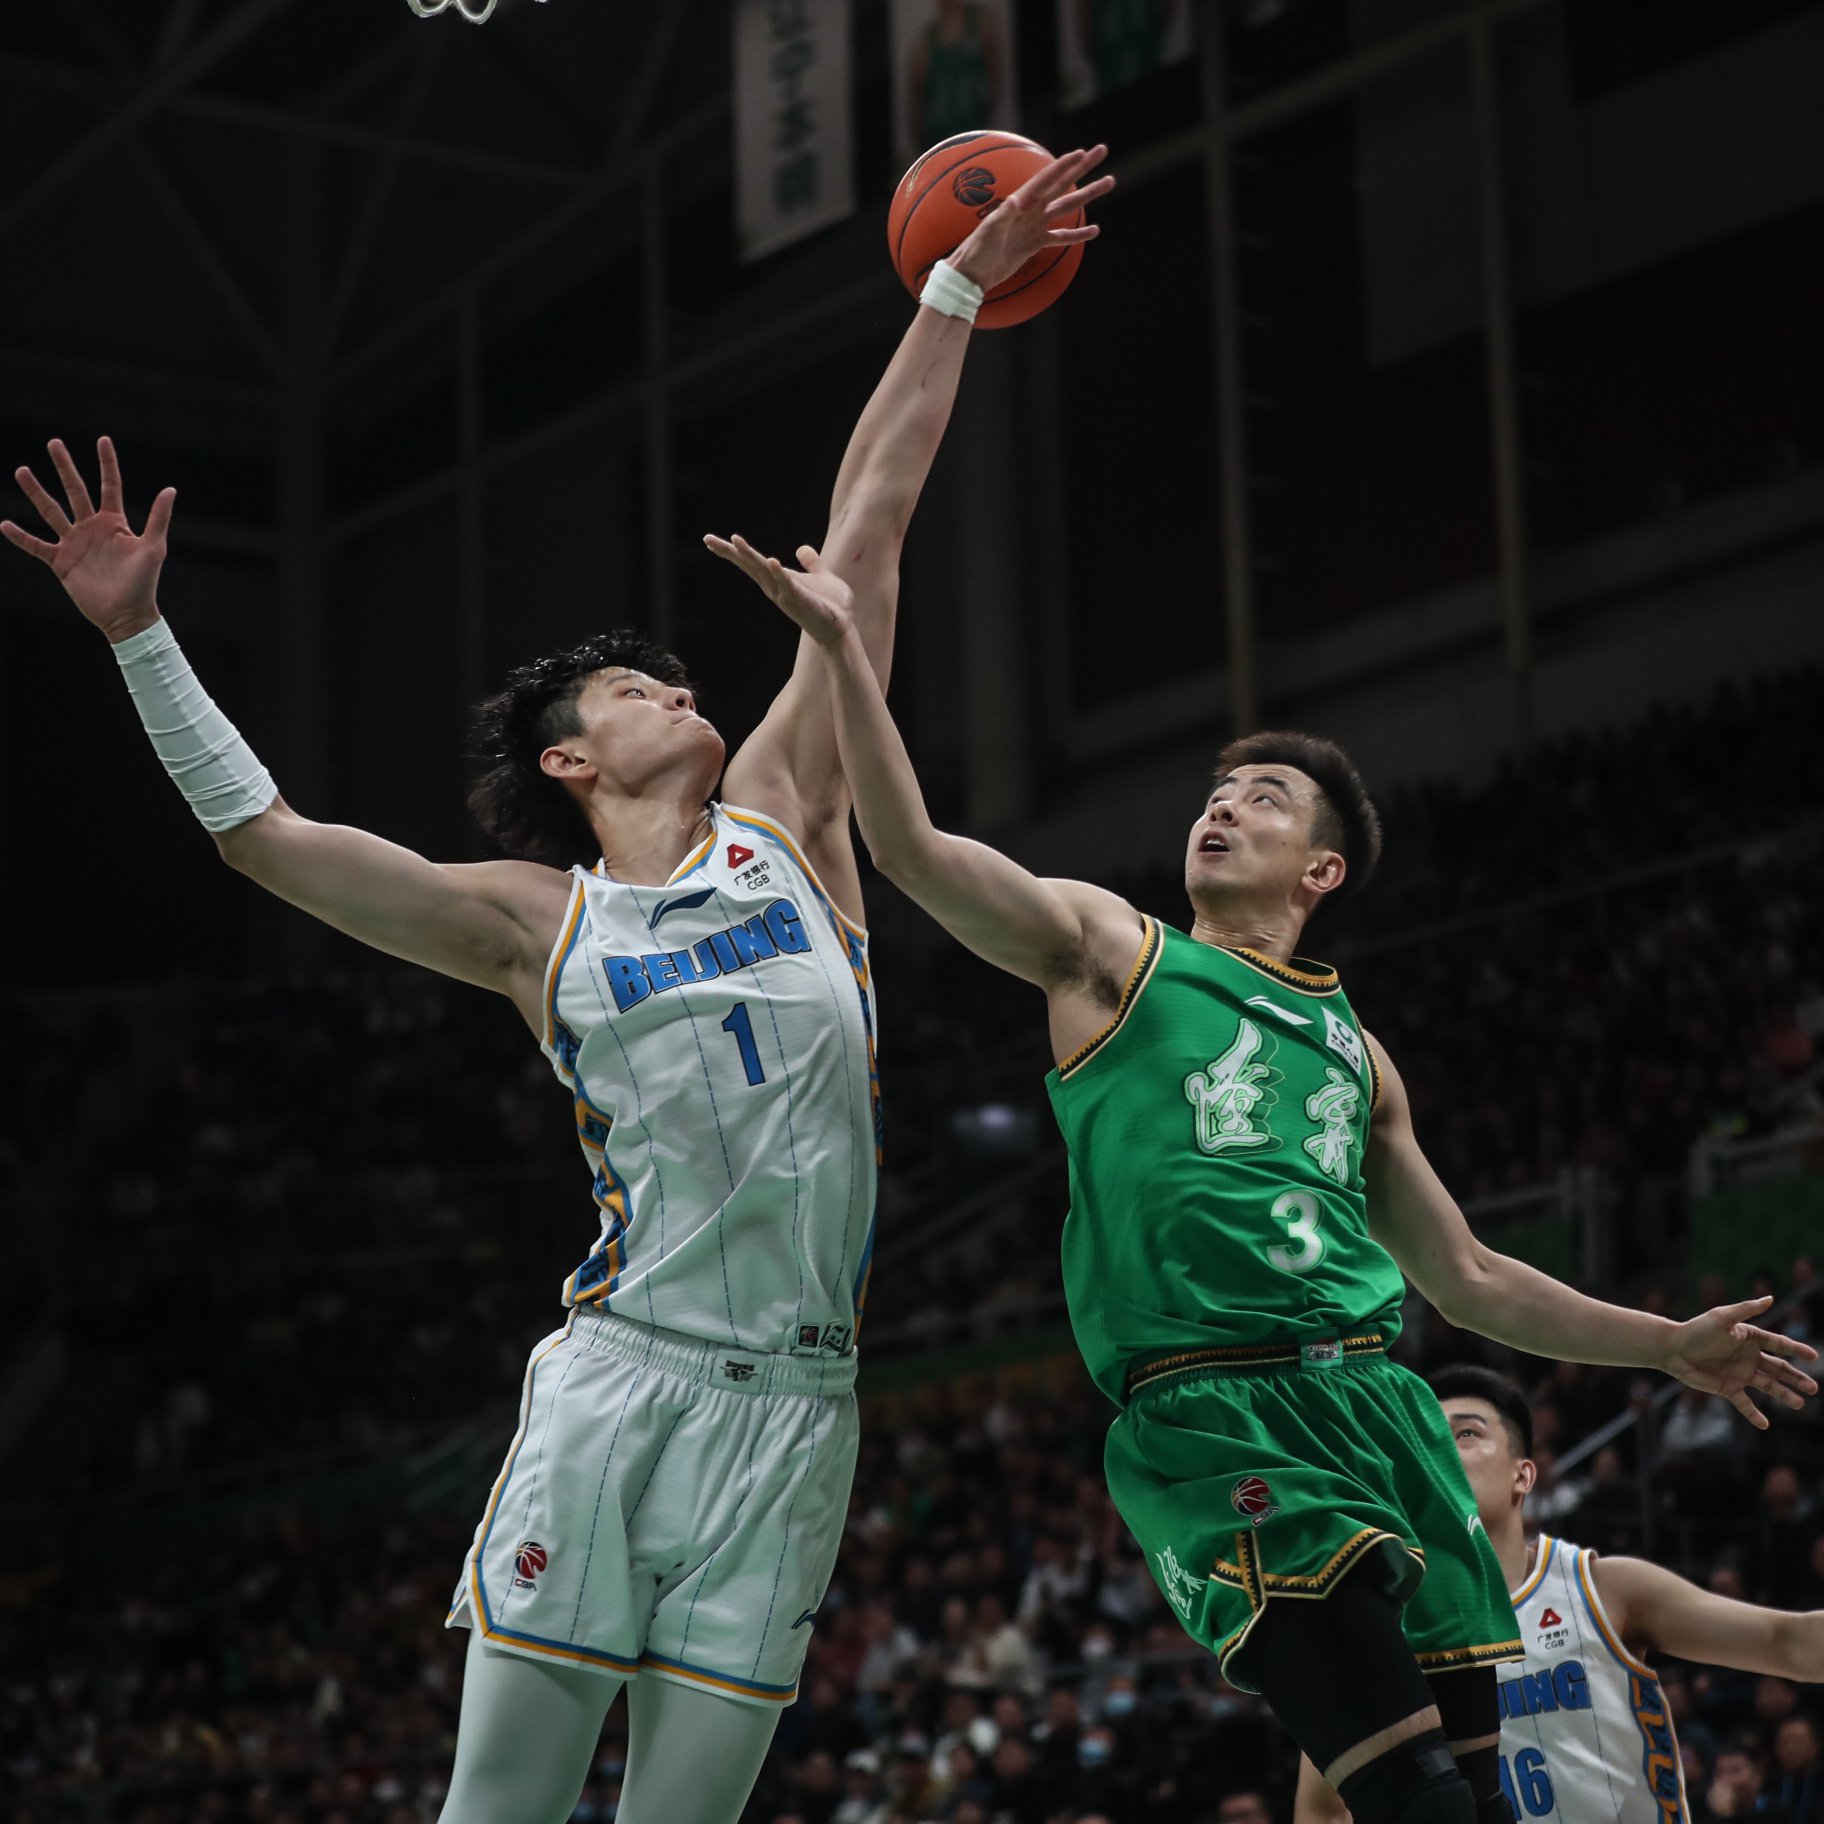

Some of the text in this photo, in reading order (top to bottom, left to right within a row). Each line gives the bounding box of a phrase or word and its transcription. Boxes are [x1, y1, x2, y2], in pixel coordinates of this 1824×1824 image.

[747, 874, 770, 891] CGB
[602, 898, 812, 1014] BEIJING
[721, 1001, 766, 1087] 1
[1266, 1189, 1327, 1274] 3
[1544, 1639, 1566, 1650] CGB
